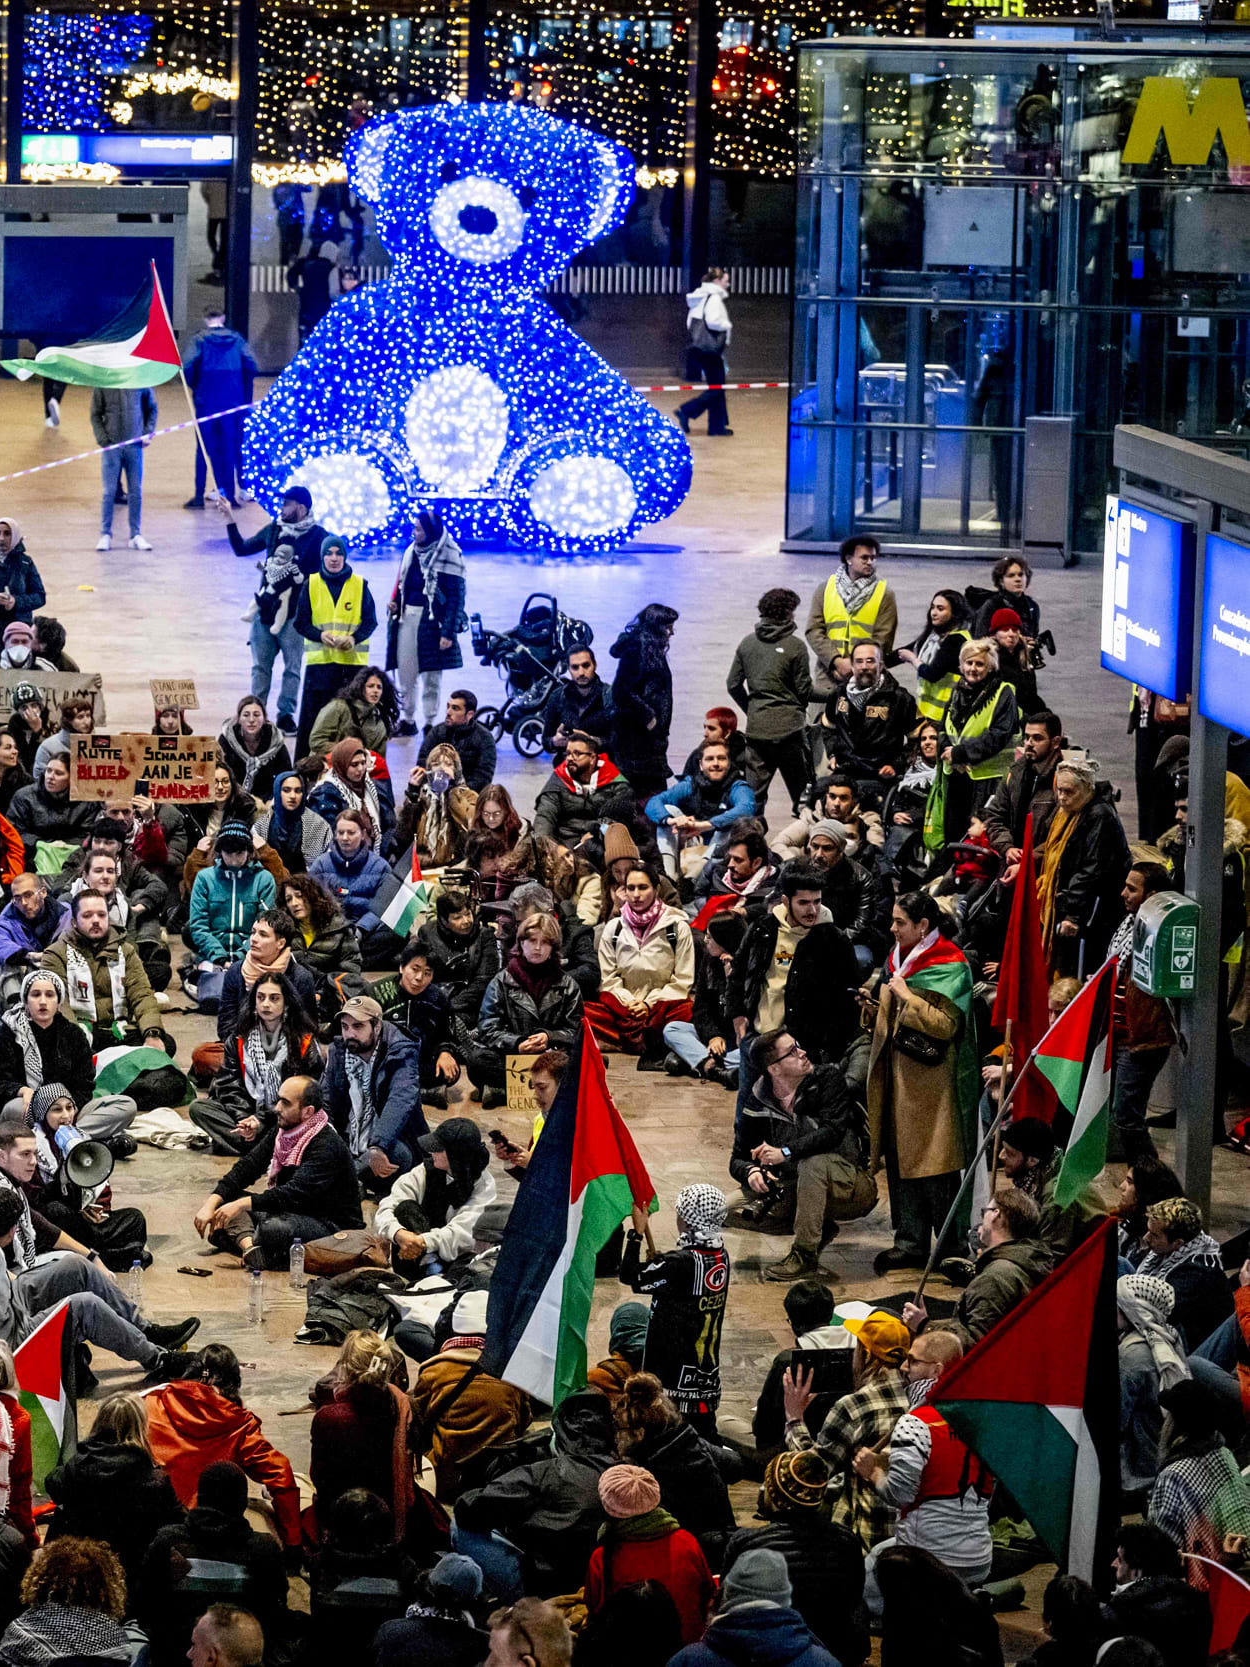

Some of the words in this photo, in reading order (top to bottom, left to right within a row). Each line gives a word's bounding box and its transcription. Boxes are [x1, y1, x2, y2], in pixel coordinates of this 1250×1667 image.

[77, 740, 123, 760] RUTTE
[200, 751, 214, 762] JE
[77, 764, 130, 780] BLOED
[142, 764, 170, 780] AAN
[174, 765, 193, 780] JE
